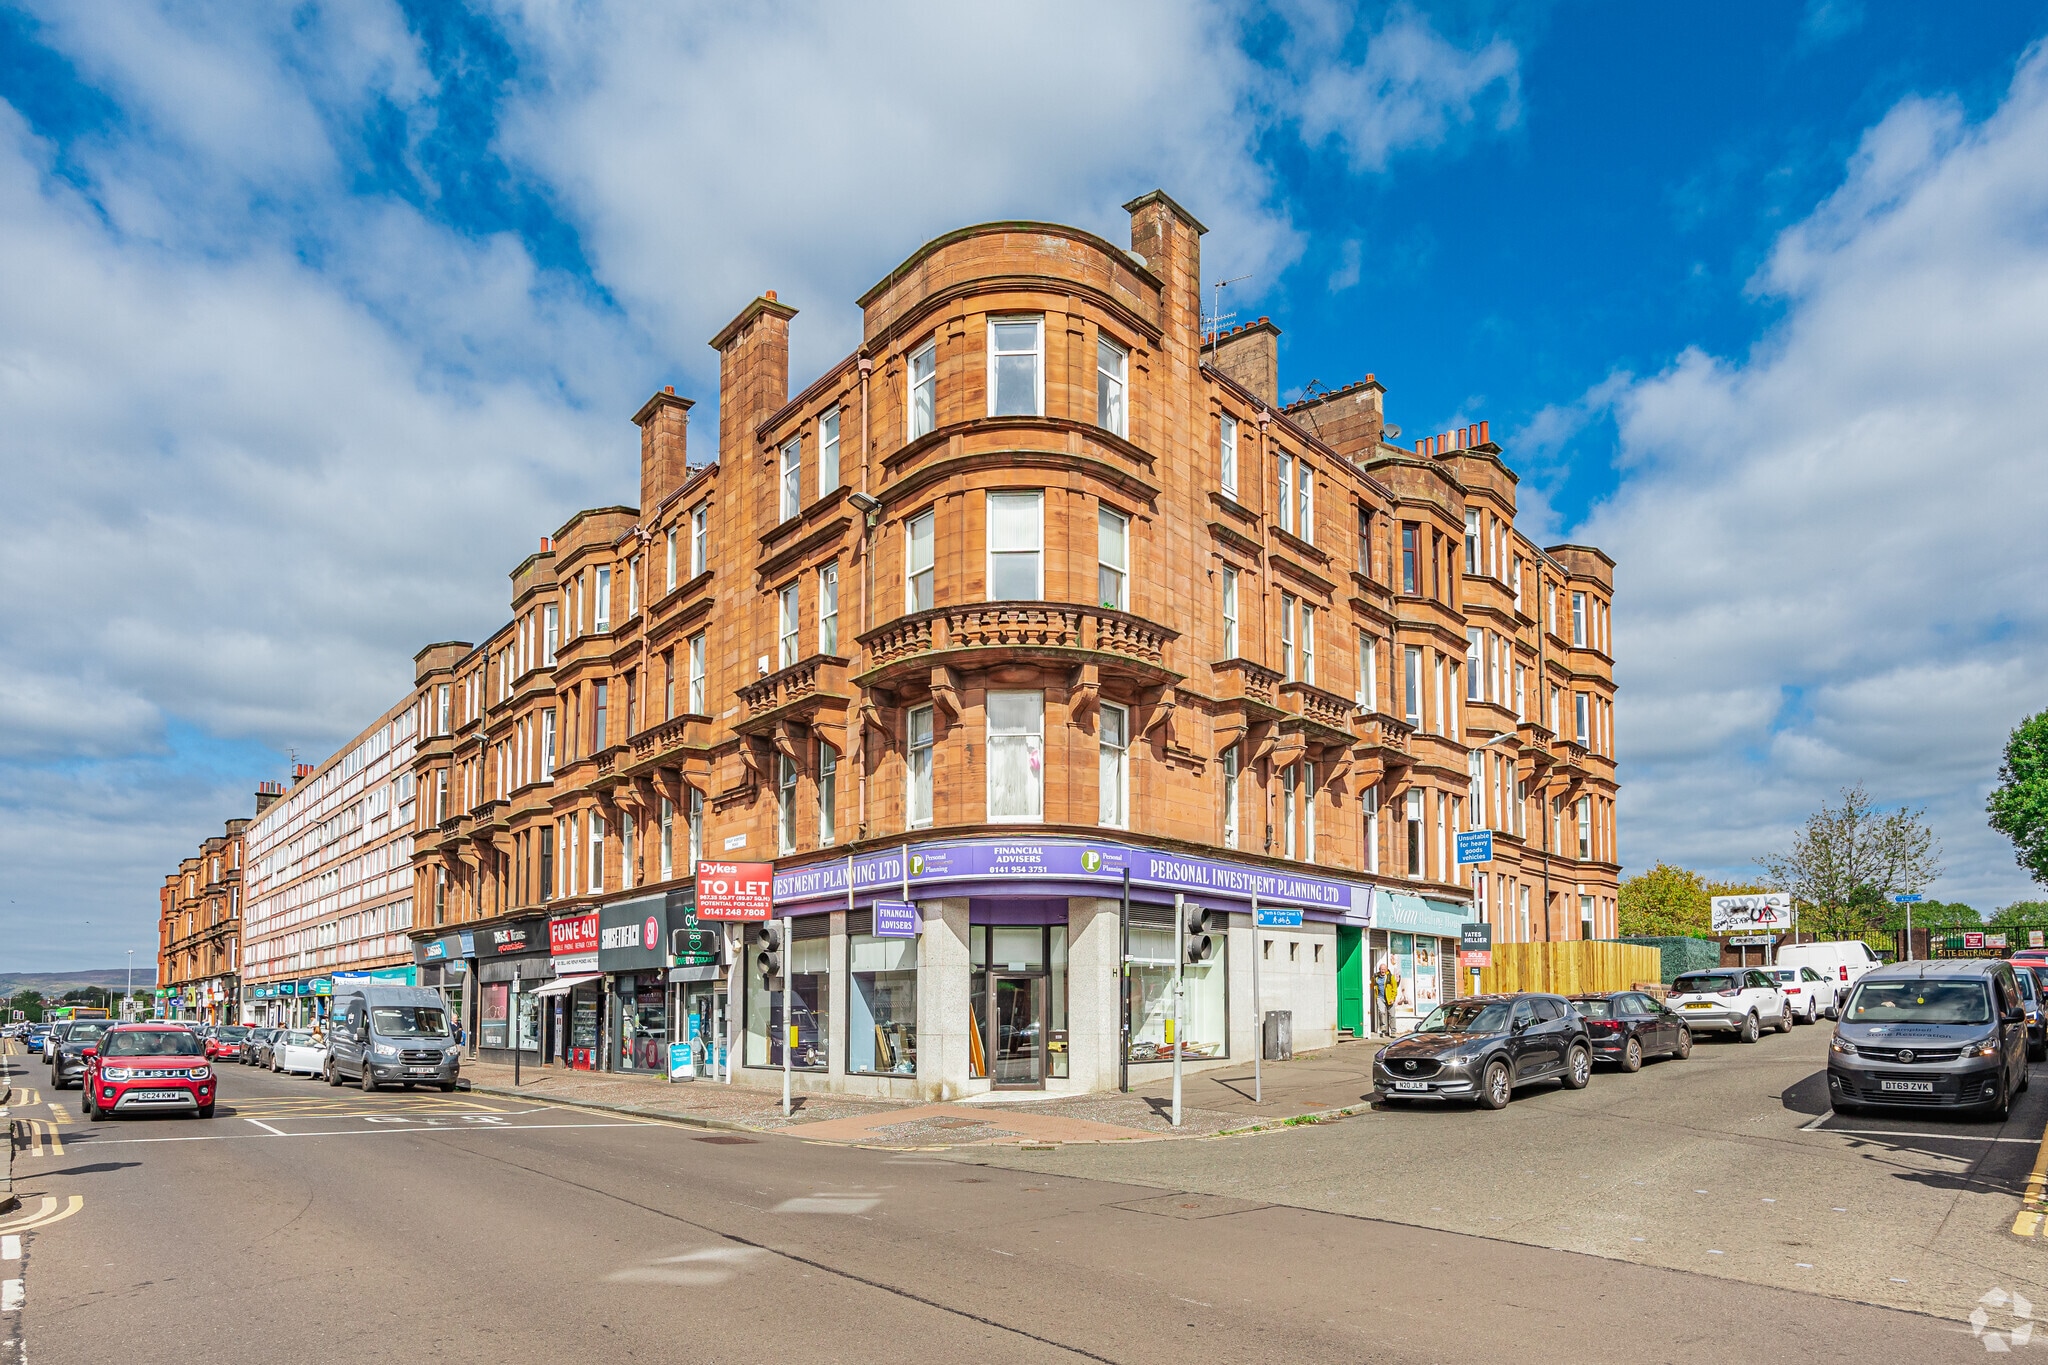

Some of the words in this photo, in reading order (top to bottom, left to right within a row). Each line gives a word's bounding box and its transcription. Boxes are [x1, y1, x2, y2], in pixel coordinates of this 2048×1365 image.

[1458, 833, 1490, 841] Unsuitable
[994, 847, 1044, 855] FINANCIAL
[1465, 847, 1483, 855] goods
[925, 853, 947, 861] Personal
[996, 855, 1042, 863] ADVISERS
[1102, 852, 1122, 861] Personal
[700, 863, 737, 875] Dykes
[925, 866, 949, 874] Planning
[1102, 865, 1124, 874] Planning
[823, 862, 876, 889] PLANNING
[879, 859, 900, 880] LTD
[1150, 858, 1210, 885] PERSONAL
[1212, 868, 1276, 894] INVESTMENT
[1278, 879, 1323, 901] PLANNING
[1323, 886, 1340, 903] LTD
[701, 880, 728, 895] TO
[734, 881, 770, 896] LET
[725, 908, 742, 916] 248
[744, 908, 766, 916] 7808
[879, 908, 914, 919] FINANCIAL
[1389, 898, 1418, 926] Siam
[880, 921, 913, 930] ADVISERS
[552, 920, 580, 943] FONE
[581, 918, 597, 939] 4U
[1937, 949, 1957, 957] SITE
[1957, 949, 2003, 957] ENTRANCE
[1885, 1082, 1909, 1090] DT69
[1911, 1082, 1930, 1091] ZVK
